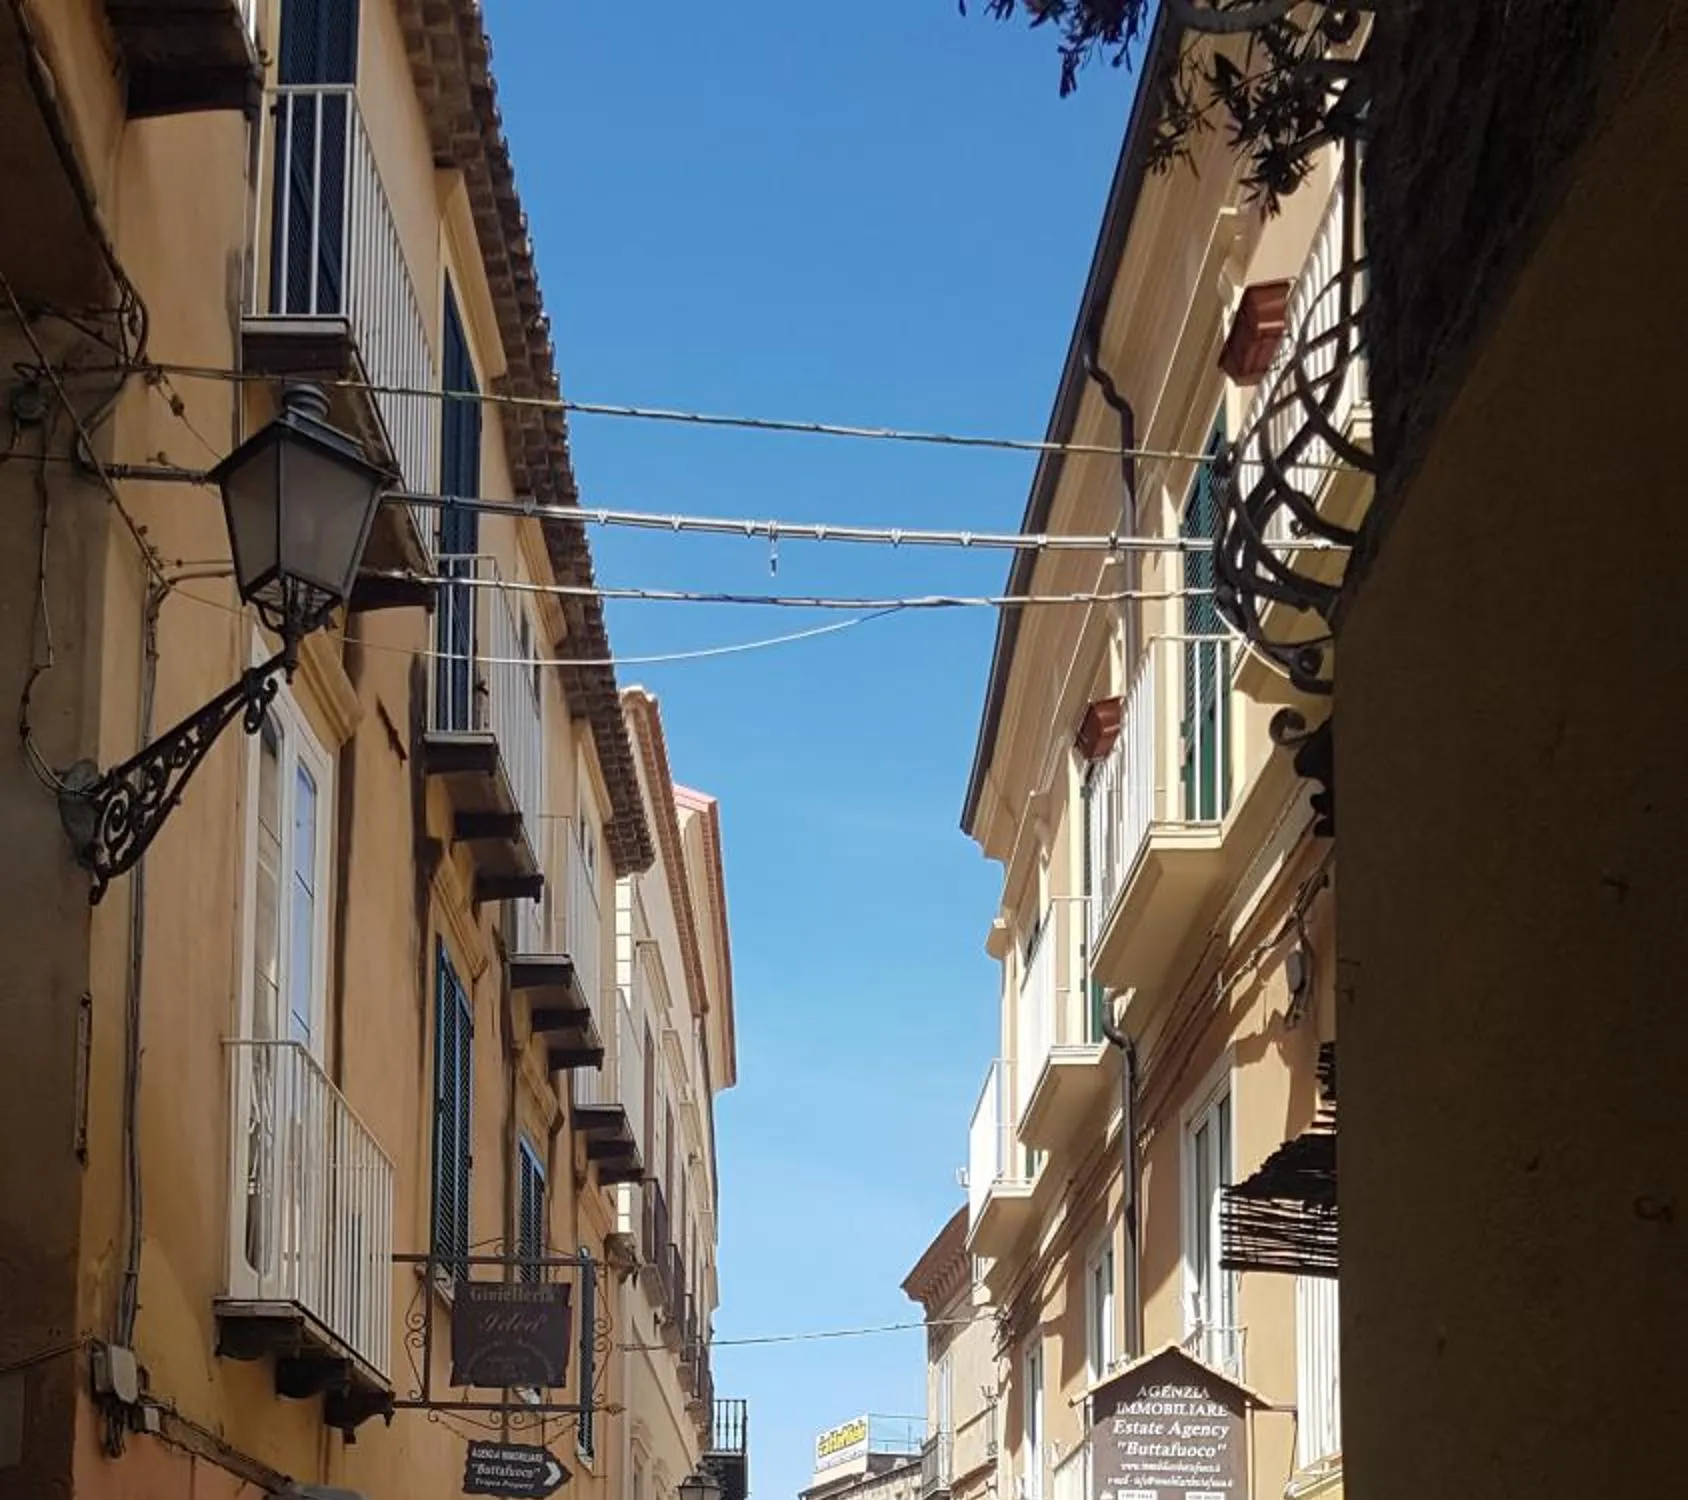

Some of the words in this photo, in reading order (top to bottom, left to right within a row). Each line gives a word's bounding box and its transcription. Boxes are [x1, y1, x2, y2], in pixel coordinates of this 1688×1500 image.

[1136, 1384, 1211, 1400] AGENZIA
[1116, 1402, 1229, 1418] IMMOBILIARE
[1113, 1420, 1165, 1436] Estate
[1167, 1421, 1231, 1440] Agency
